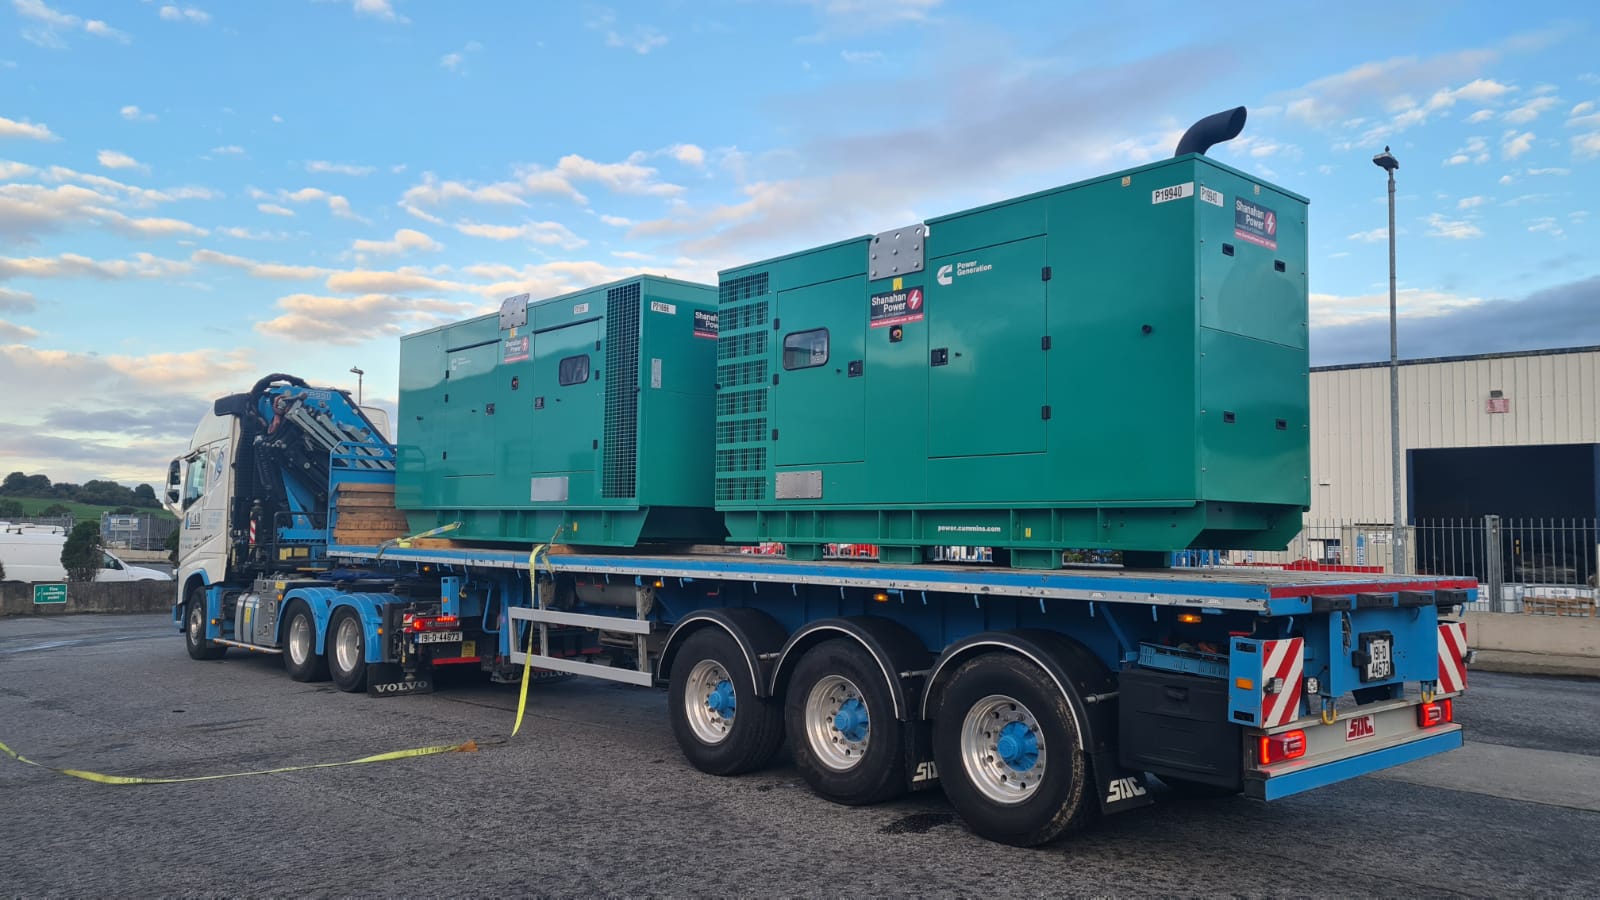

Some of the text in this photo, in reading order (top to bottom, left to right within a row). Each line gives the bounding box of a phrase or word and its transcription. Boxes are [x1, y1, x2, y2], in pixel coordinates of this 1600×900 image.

[1155, 186, 1182, 202] P19940
[1202, 188, 1217, 204] P19940
[1236, 200, 1264, 217] Shanahan
[1246, 214, 1264, 230] Power
[957, 260, 977, 269] Power
[957, 264, 992, 276] Generation
[871, 293, 906, 306] Shanahan
[884, 302, 906, 313] Power
[374, 680, 428, 693] VOLVO
[1106, 776, 1146, 803] SDC
